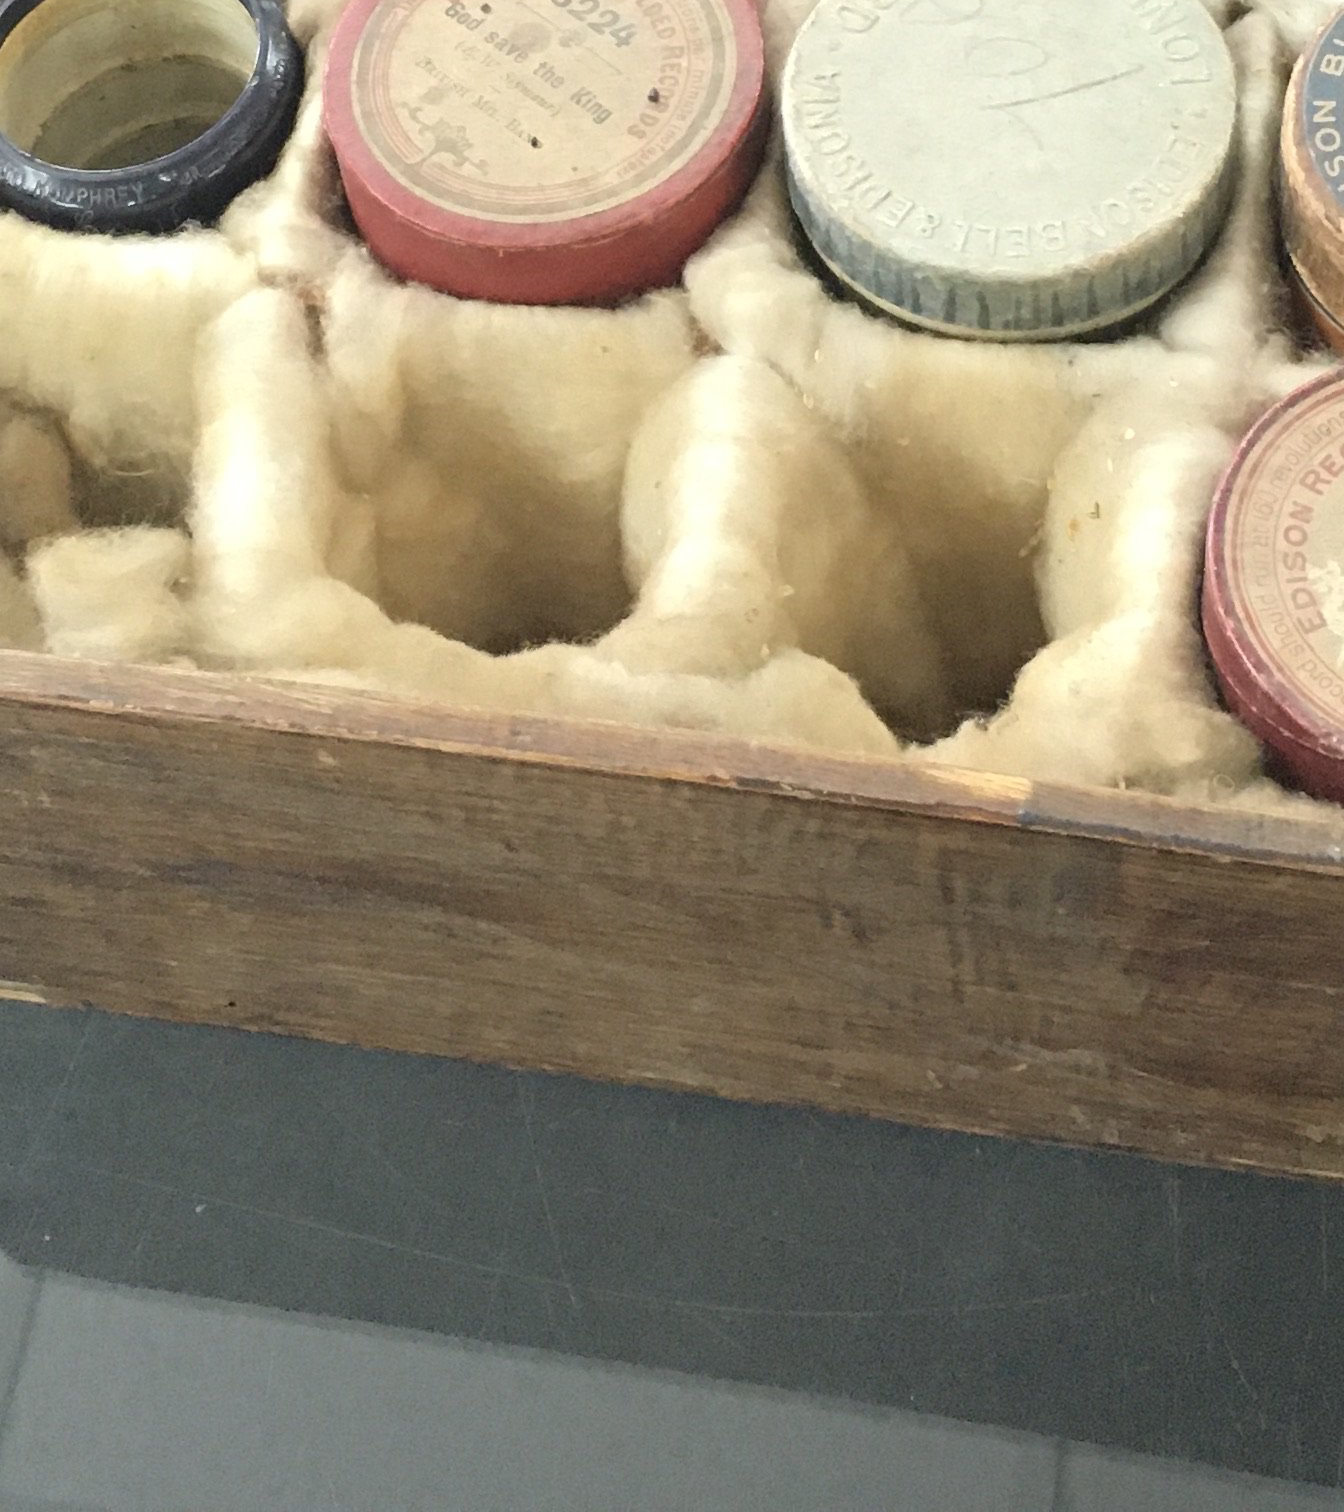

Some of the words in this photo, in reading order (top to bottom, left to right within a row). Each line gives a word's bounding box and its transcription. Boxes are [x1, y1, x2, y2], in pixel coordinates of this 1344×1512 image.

[415, 55, 468, 99] BRITISH
[444, 1, 486, 30] God
[483, 29, 531, 64] save
[532, 60, 565, 89] the
[569, 86, 613, 125] King
[802, 71, 918, 229] EDISONIA
[955, 220, 1066, 258] BELL
[1282, 500, 1328, 635] EDISON
[1262, 597, 1314, 674] should
